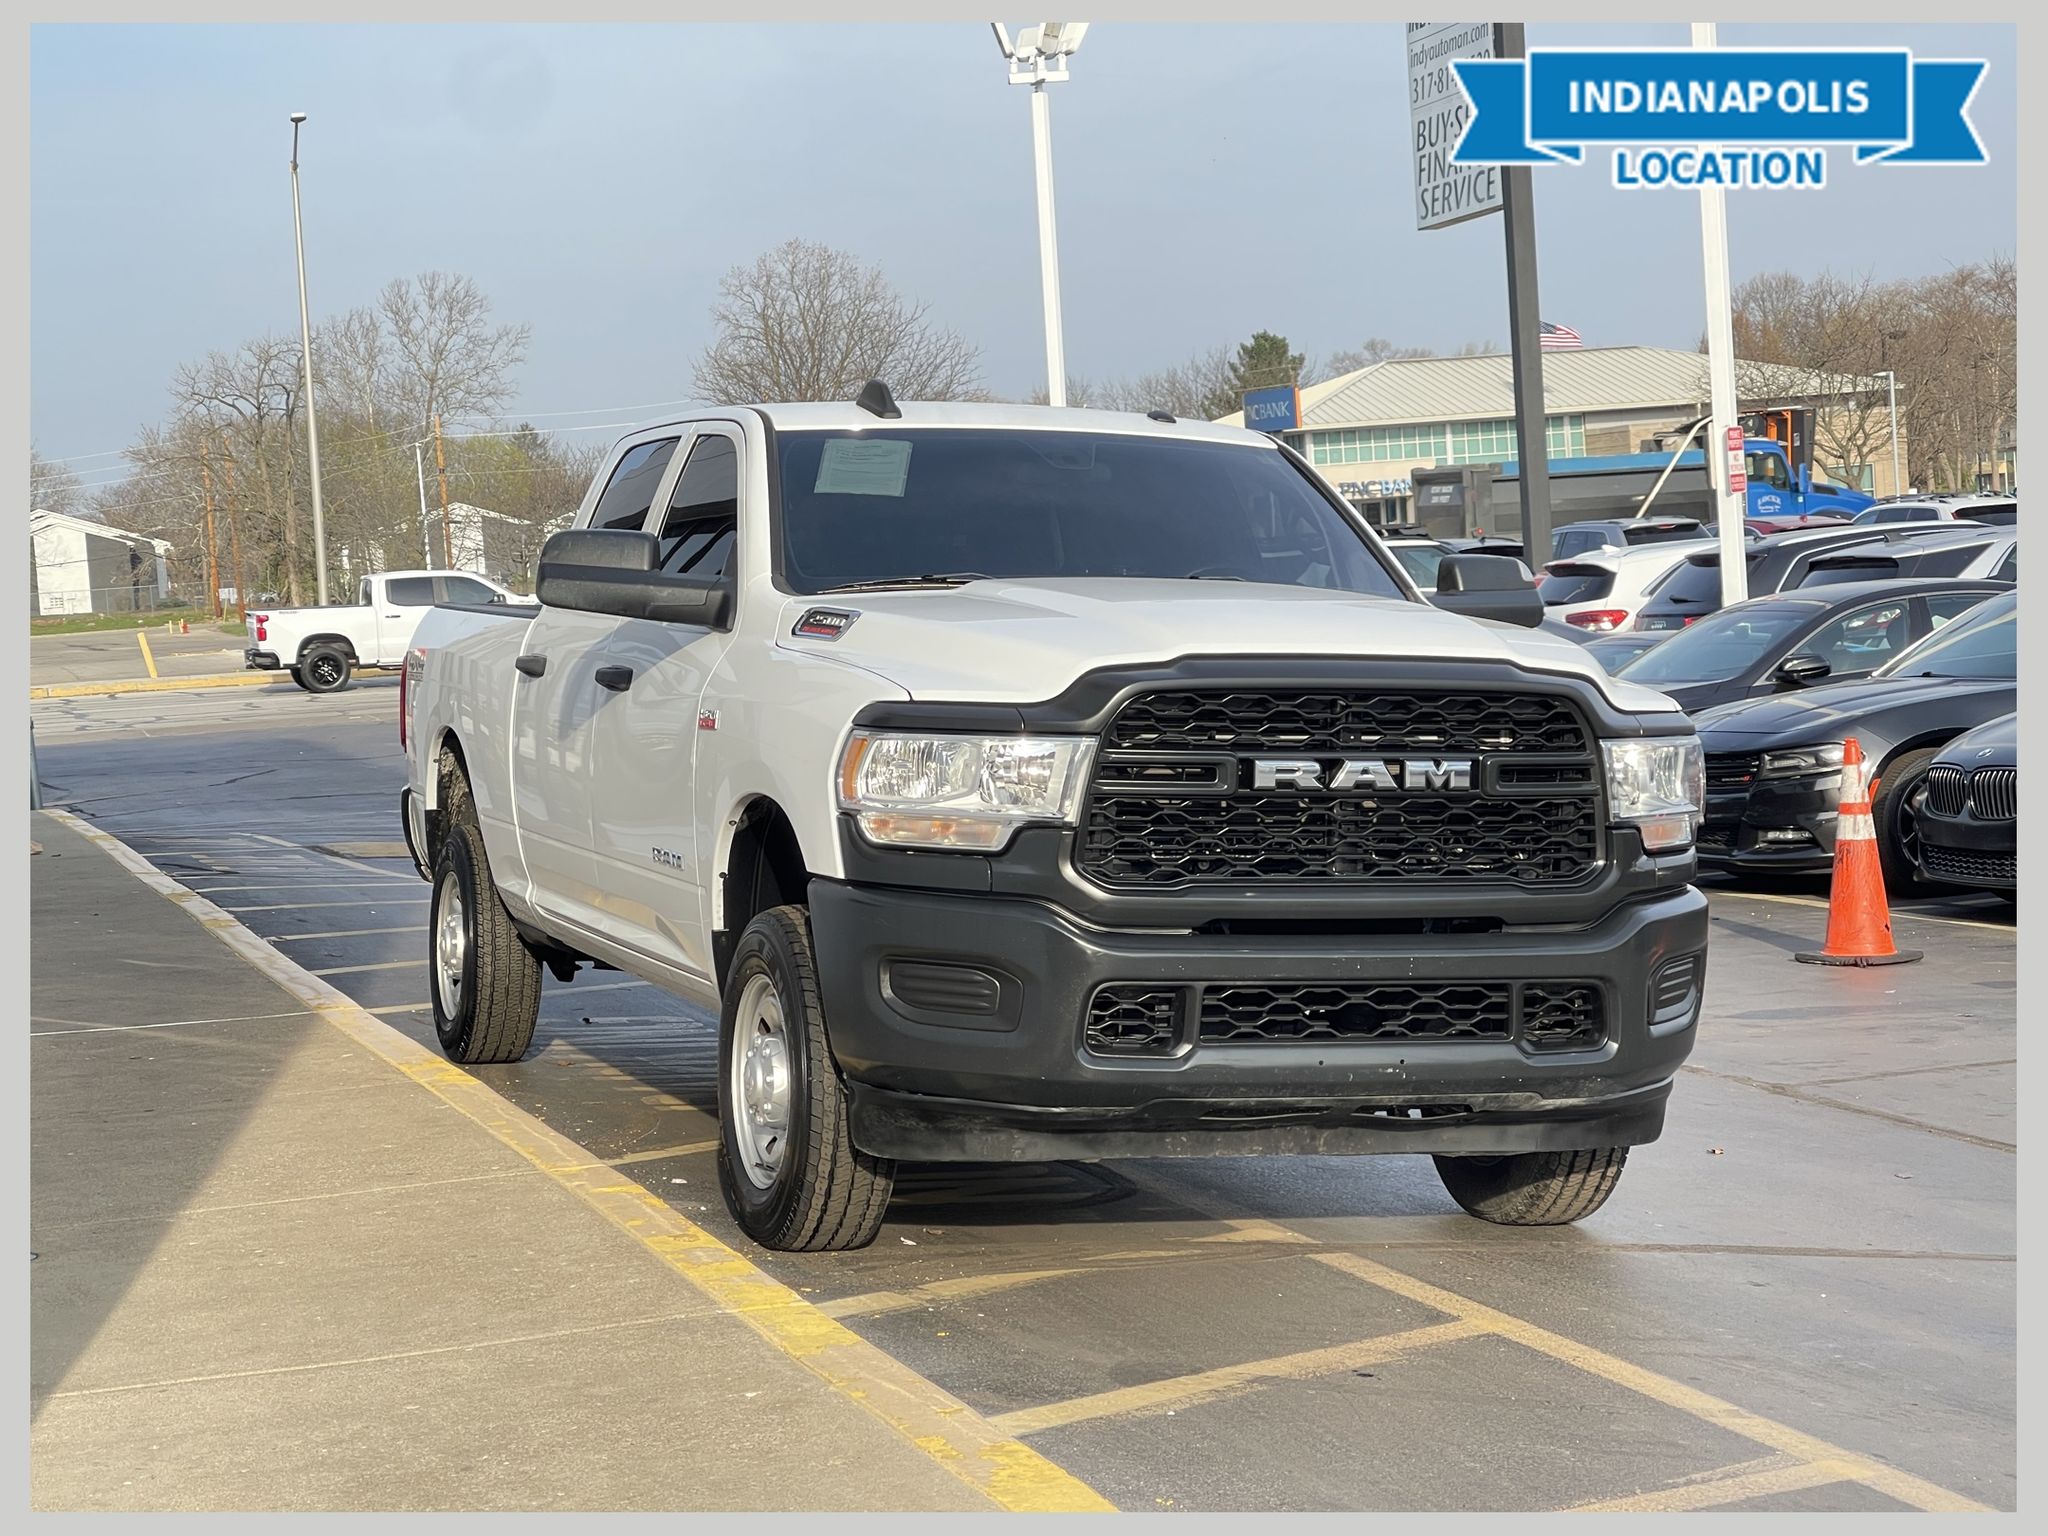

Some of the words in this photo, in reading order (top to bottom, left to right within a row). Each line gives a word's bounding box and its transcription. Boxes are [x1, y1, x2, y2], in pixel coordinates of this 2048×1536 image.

[1410, 22, 1489, 69] indyautoman.com
[1420, 167, 1497, 220] SERVICE
[1253, 758, 1473, 792] RAM
[652, 846, 685, 870] RAM
